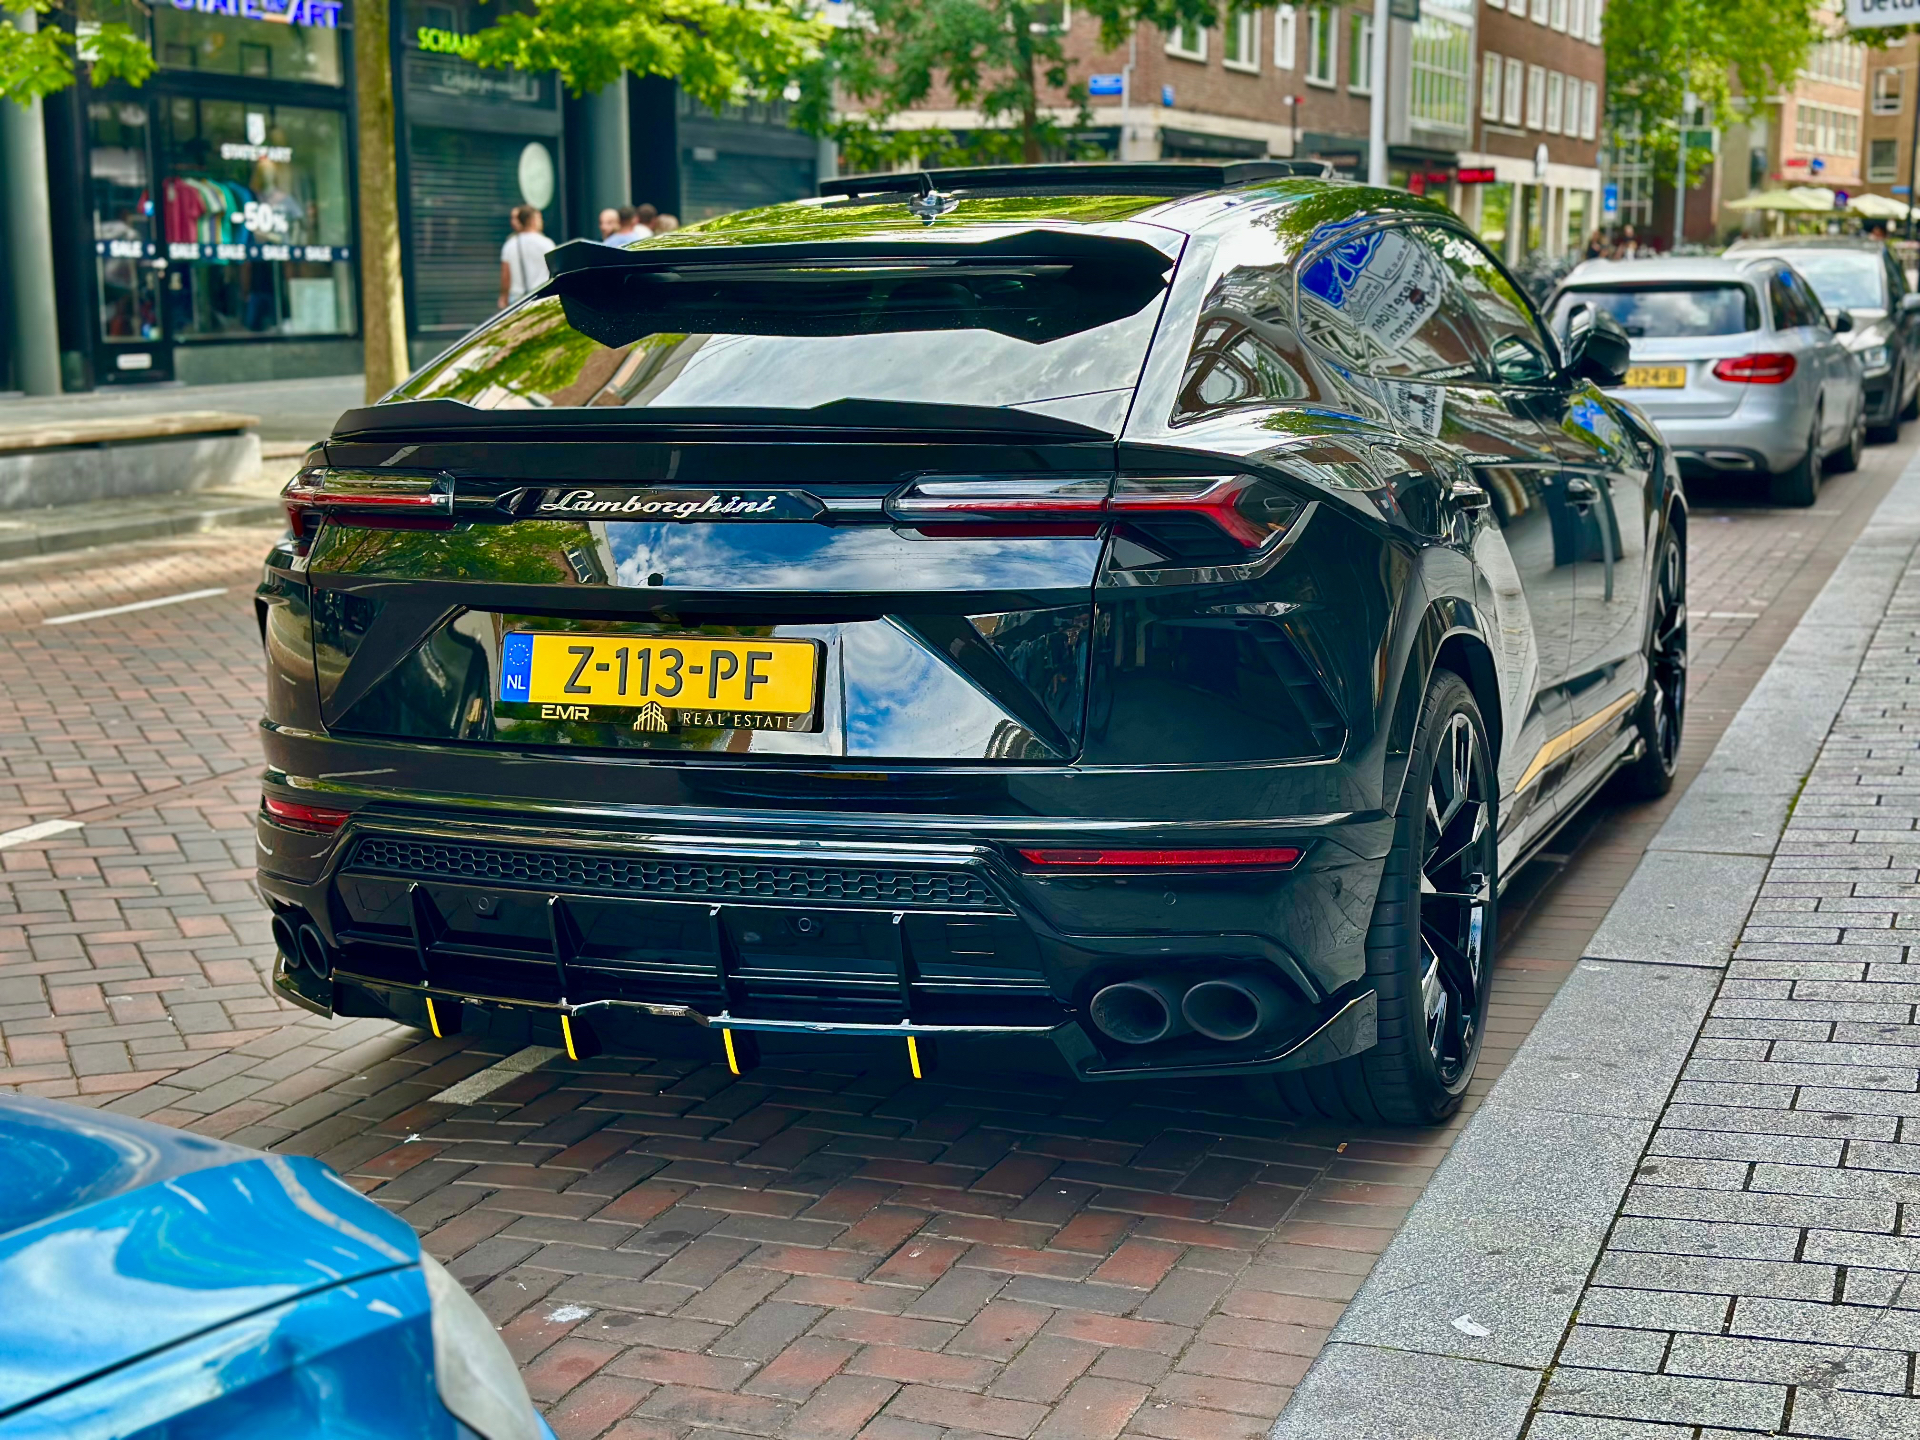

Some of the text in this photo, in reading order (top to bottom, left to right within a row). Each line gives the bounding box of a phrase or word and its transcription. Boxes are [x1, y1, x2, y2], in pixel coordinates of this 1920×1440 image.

[231, 201, 288, 233] -50%
[110, 240, 142, 258] SALE
[169, 243, 332, 262] SALE SALE SALE SALE
[541, 491, 777, 518] Lamborghini
[506, 674, 526, 690] NL
[564, 646, 772, 700] Z-113-PF
[541, 704, 590, 721] EMR
[683, 712, 794, 729] REAL ESTATE
